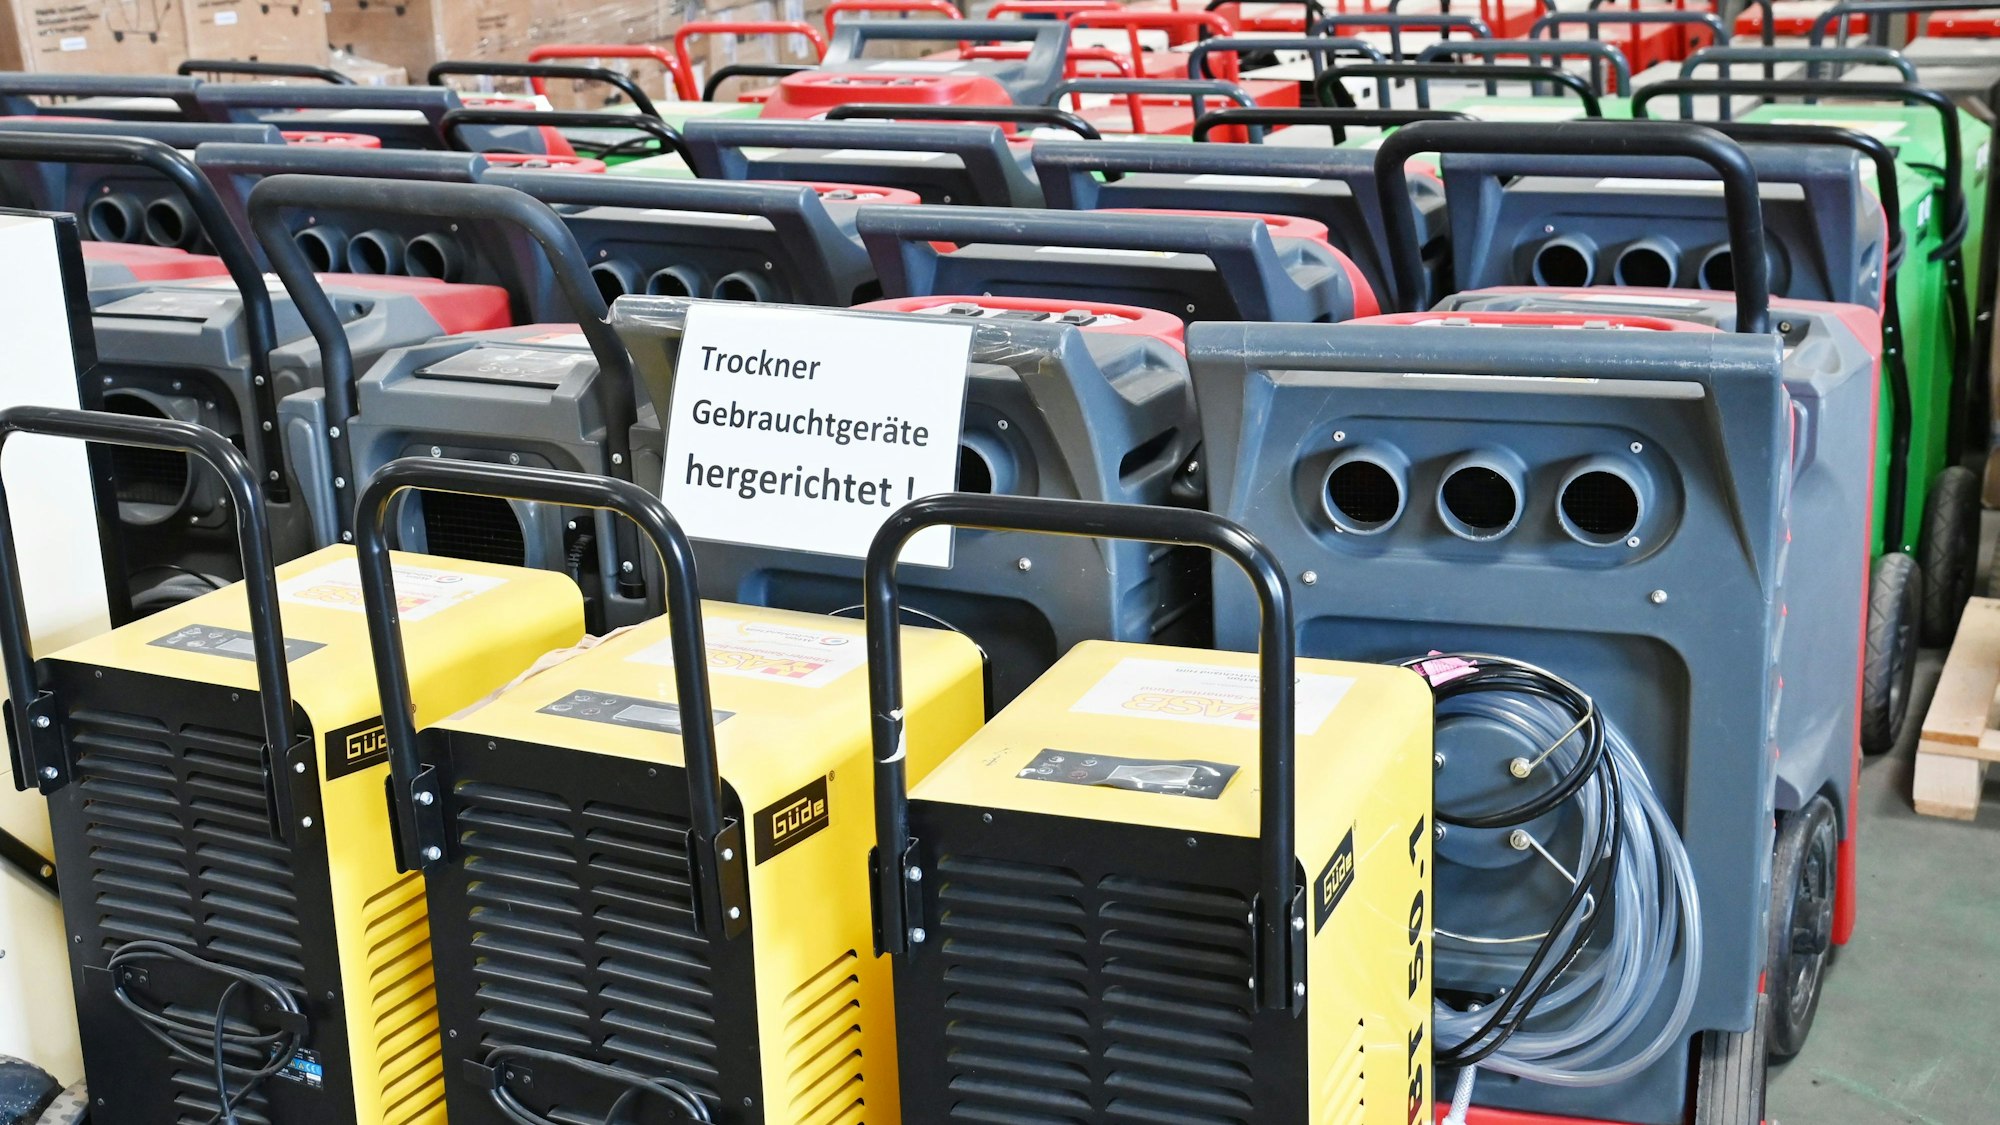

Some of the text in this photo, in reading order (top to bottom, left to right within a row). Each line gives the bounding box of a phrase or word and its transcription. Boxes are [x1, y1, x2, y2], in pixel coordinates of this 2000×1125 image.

[701, 346, 821, 380] Trockner
[692, 399, 930, 447] Gebrauchtgeräte
[685, 453, 892, 508] hergerichtet
[705, 649, 791, 671] AS
[1122, 693, 1253, 717] ASB
[773, 797, 824, 839] Güde
[1324, 851, 1353, 905] Güde
[1408, 813, 1424, 1000] 50.1
